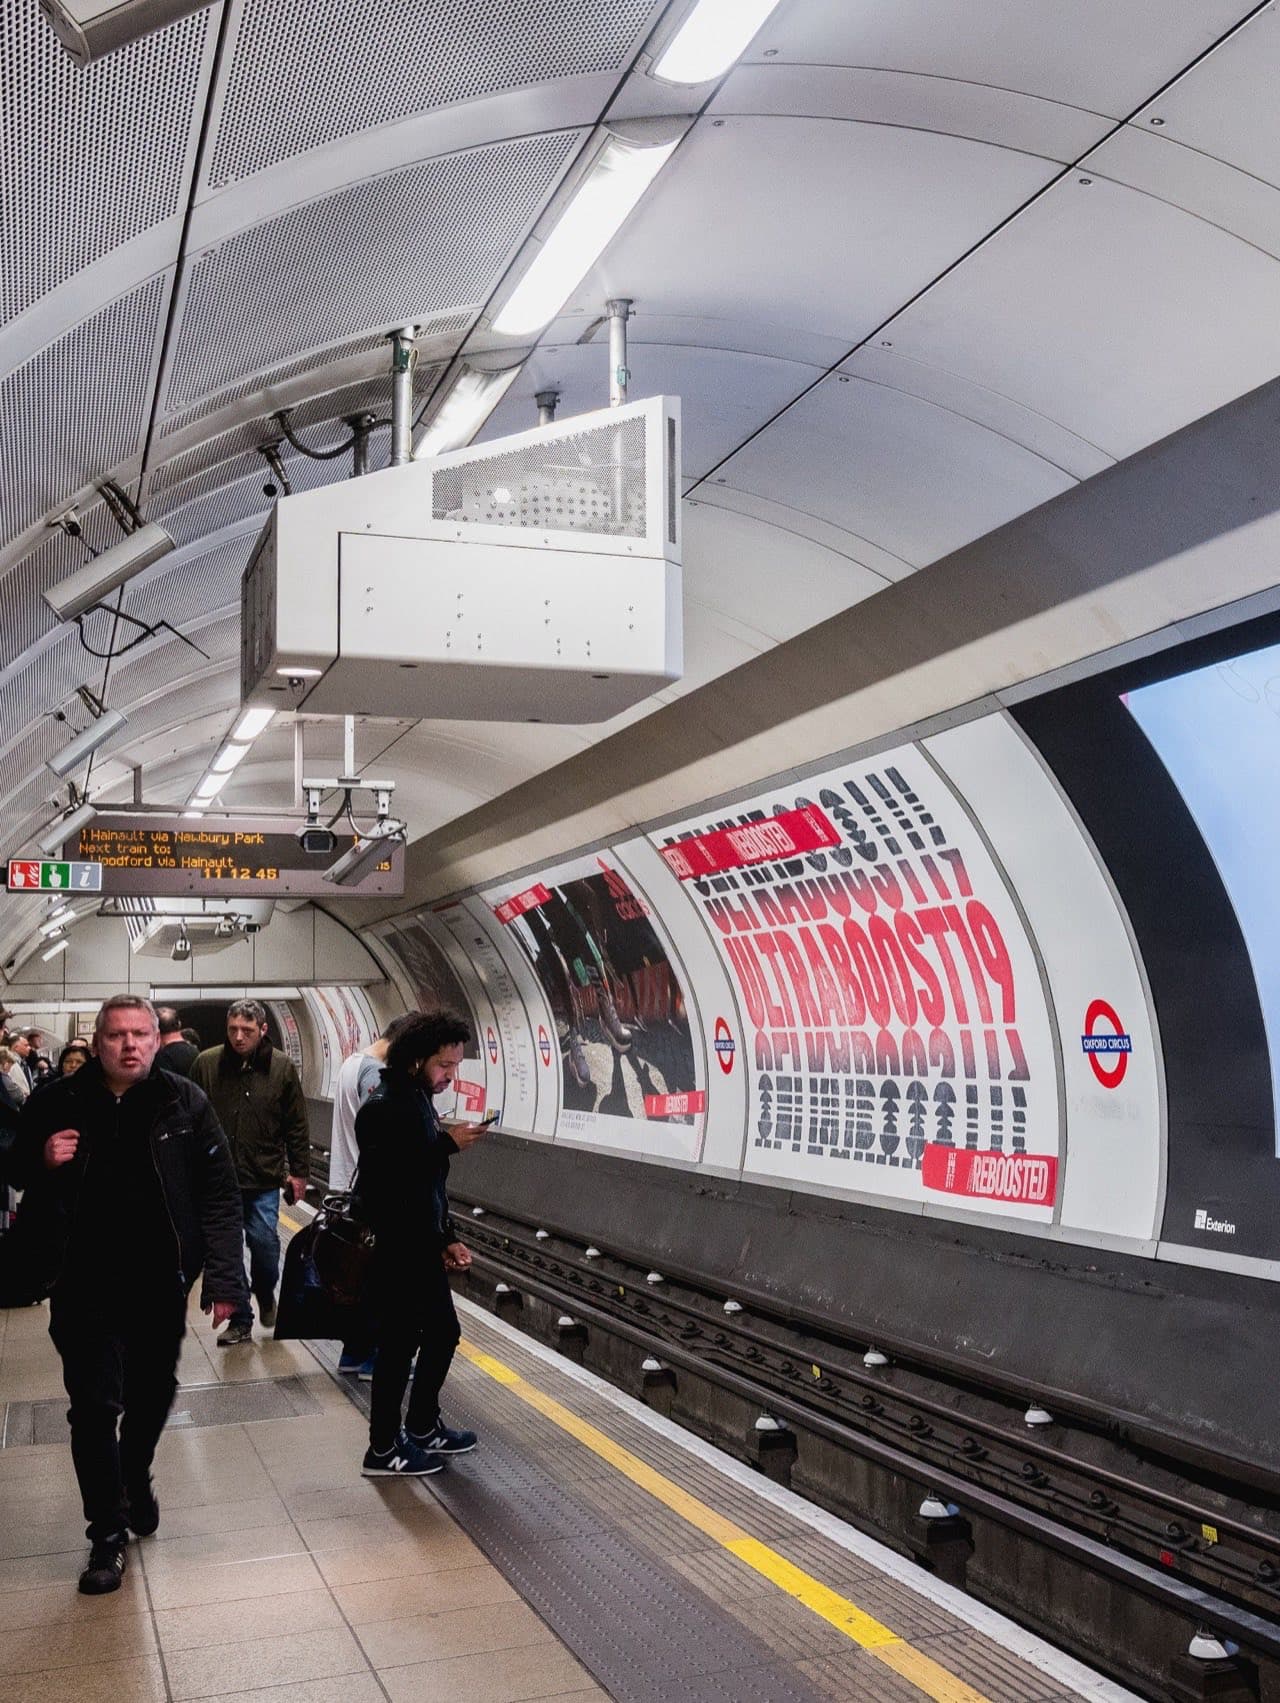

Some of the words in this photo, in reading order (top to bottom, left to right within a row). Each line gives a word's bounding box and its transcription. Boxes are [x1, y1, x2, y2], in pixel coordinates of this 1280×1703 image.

[90, 829, 146, 842] Hainault
[151, 831, 169, 842] via
[175, 832, 230, 845] Newbury
[235, 833, 265, 844] Park
[80, 843, 111, 854] Next
[117, 844, 148, 854] train
[154, 844, 171, 855] to:
[158, 857, 176, 867] via
[182, 857, 235, 868] Hainault
[723, 900, 1016, 1030] ULTRABOOST19
[1084, 1039, 1107, 1049] OXFORD
[1108, 1039, 1130, 1049] CIRCUS
[972, 1155, 1049, 1201] REBOOSTED
[1206, 1217, 1236, 1234] Exterion
